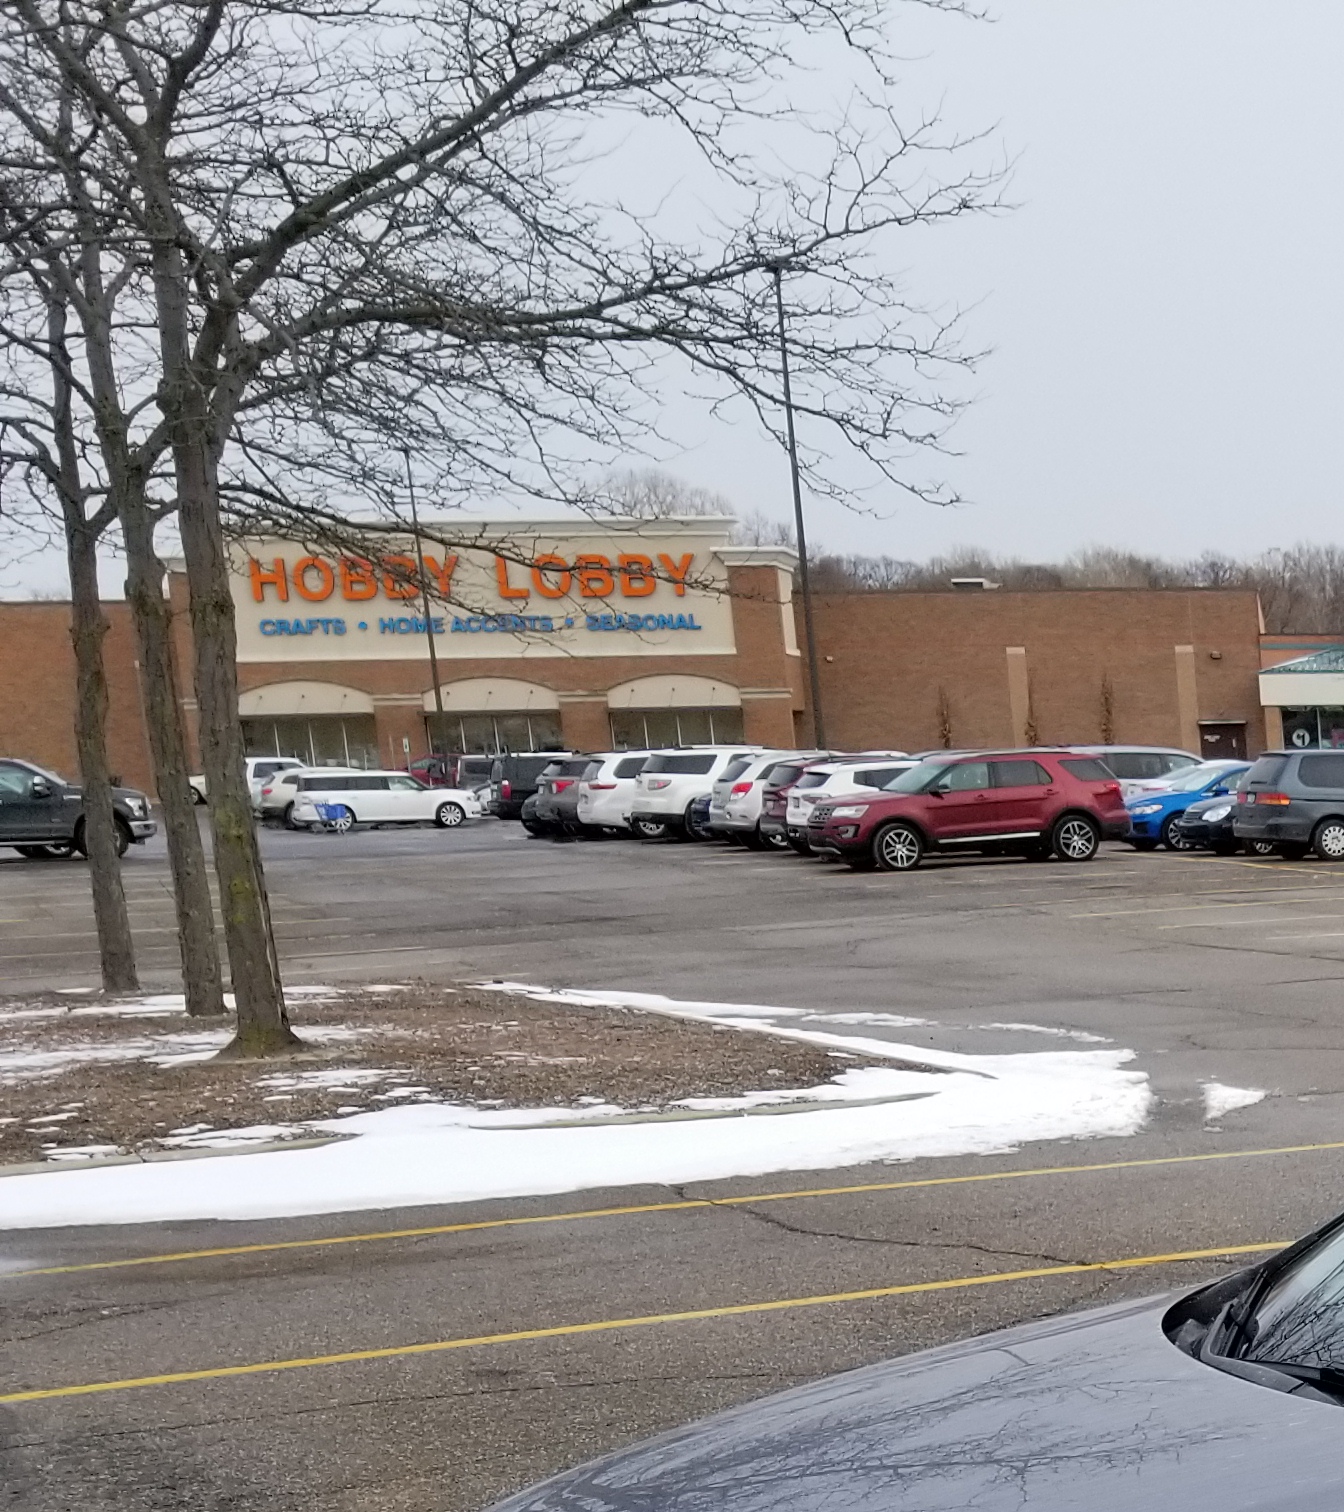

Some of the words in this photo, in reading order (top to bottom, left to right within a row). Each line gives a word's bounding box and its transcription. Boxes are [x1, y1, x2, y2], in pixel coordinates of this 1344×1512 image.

[250, 555, 458, 602] HOBBY
[495, 553, 694, 599] LOBBY
[259, 617, 347, 636] CRAFTS
[379, 616, 445, 635] HOME
[451, 614, 554, 634] ACCENTS
[586, 613, 702, 632] SEASONAL
